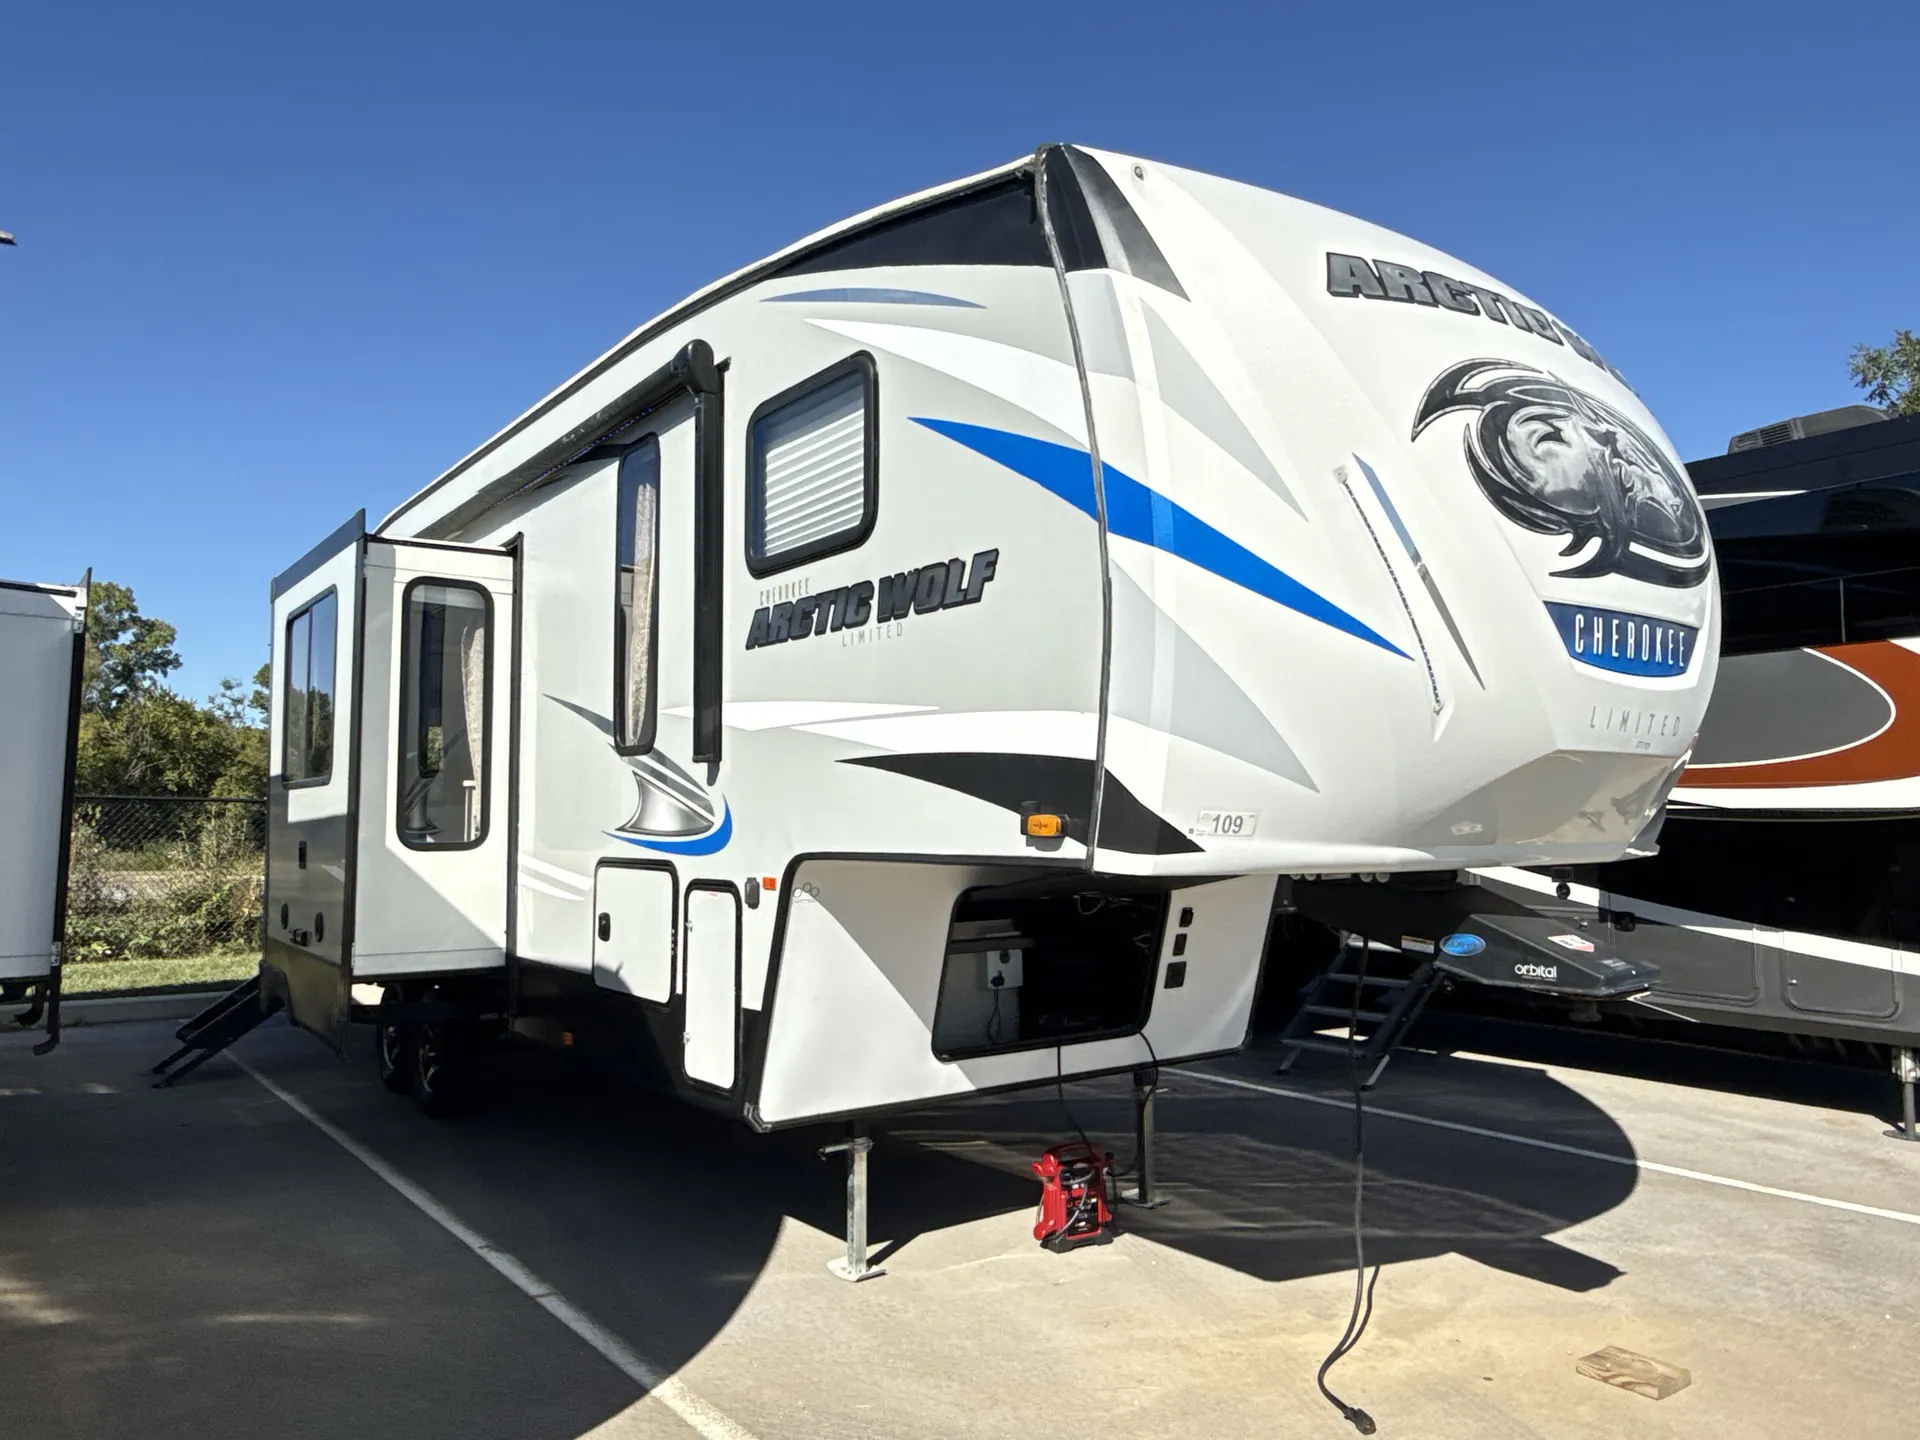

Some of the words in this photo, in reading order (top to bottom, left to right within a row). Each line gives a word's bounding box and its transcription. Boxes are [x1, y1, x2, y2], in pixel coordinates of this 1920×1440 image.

[1326, 251, 1565, 346] ARCTIC
[745, 580, 875, 651] ARCTIC
[876, 547, 1000, 623] WOLF
[758, 577, 810, 606] CHEROKEE
[841, 622, 904, 647] LIMITED
[1574, 613, 1685, 667] CHEROKEE
[1588, 705, 1681, 736] LIMITED
[1212, 813, 1244, 834] 109
[1514, 963, 1558, 979] orbital
